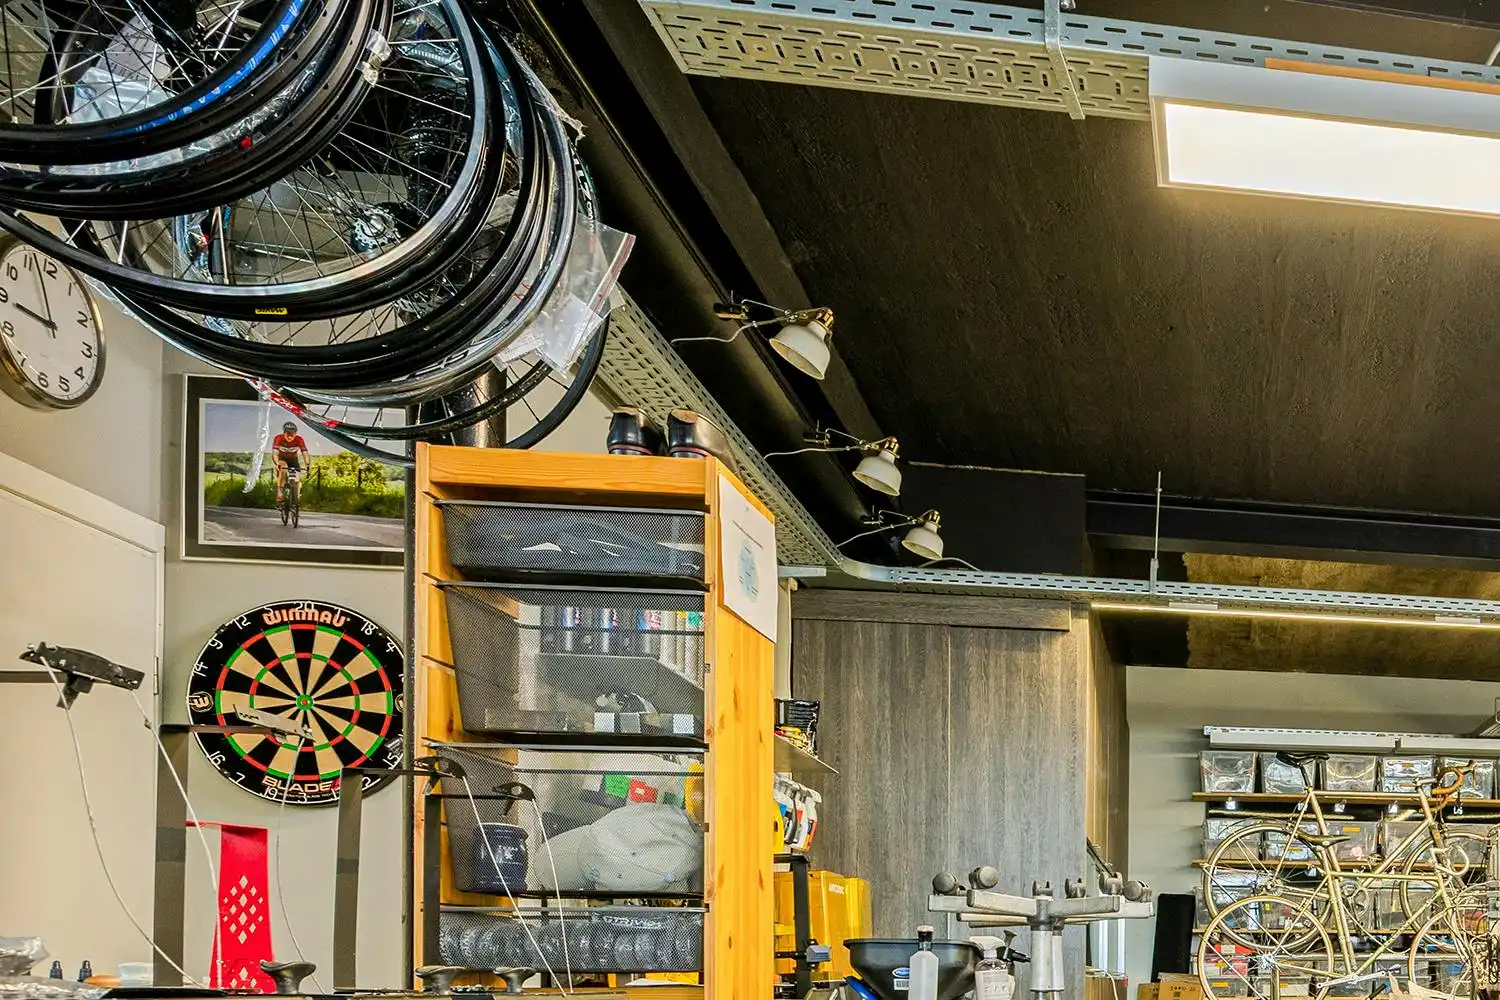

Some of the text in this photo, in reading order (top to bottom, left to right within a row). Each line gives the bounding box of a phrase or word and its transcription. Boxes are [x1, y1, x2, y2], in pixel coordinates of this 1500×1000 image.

[6, 262, 18, 281] 10
[24, 254, 33, 272] 11
[43, 258, 58, 280] 12
[0, 287, 9, 304] 9
[77, 311, 89, 329] 2
[2, 321, 15, 338] 8
[81, 341, 93, 359] 3
[17, 350, 28, 368] 7
[38, 372, 49, 389] 6
[75, 366, 86, 380] 4
[58, 375, 71, 393] 5
[294, 601, 315, 612] 20
[233, 615, 251, 630] 12
[262, 608, 346, 628] WINMAU
[360, 620, 379, 636] 18
[386, 637, 398, 653] 4
[194, 661, 209, 678] 14
[209, 751, 226, 768] 16
[236, 772, 246, 784] 7
[262, 776, 333, 792] BLADE
[264, 786, 279, 800] 19
[298, 792, 307, 802] 3
[331, 787, 338, 800] 1
